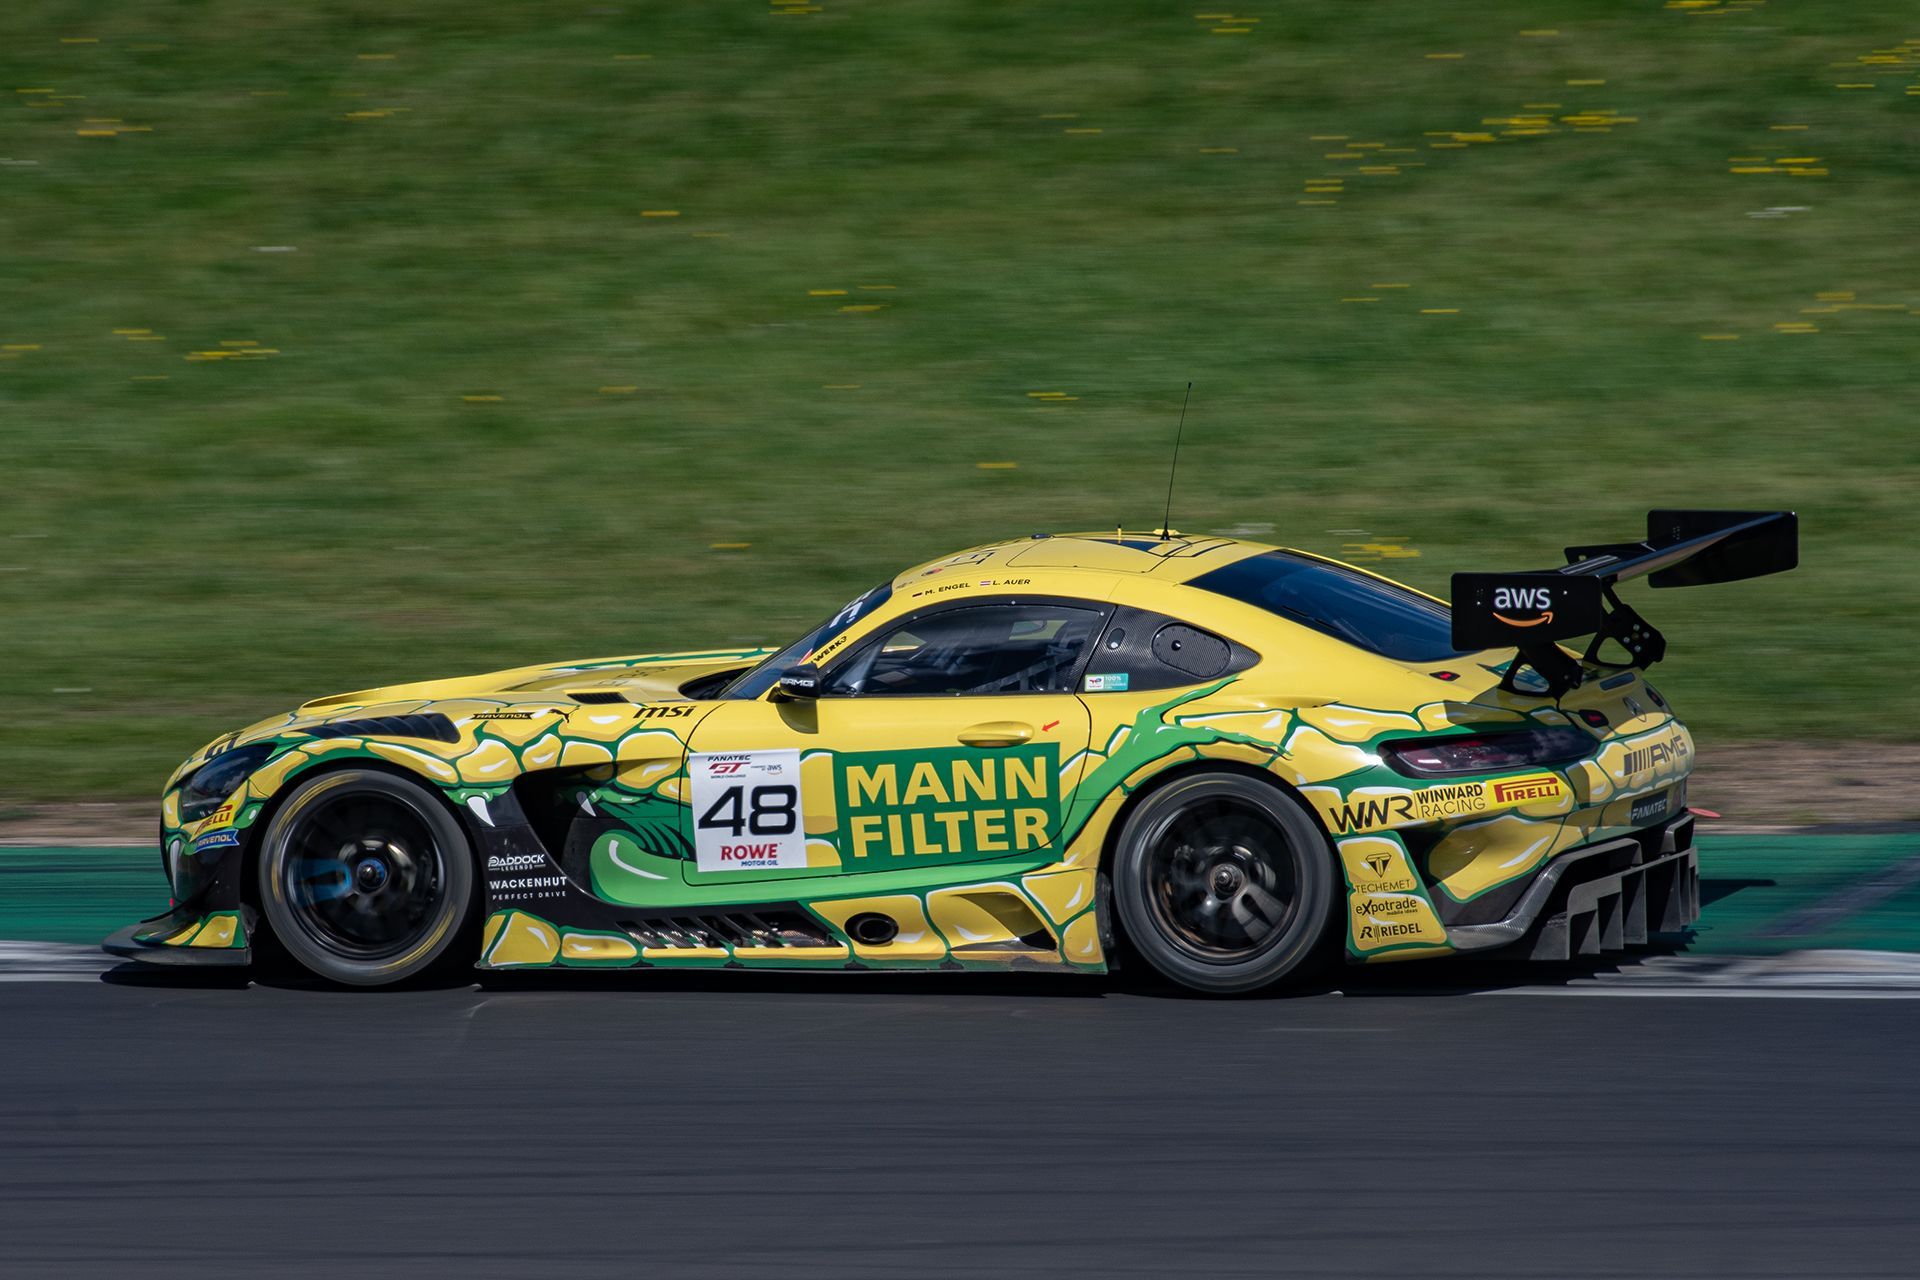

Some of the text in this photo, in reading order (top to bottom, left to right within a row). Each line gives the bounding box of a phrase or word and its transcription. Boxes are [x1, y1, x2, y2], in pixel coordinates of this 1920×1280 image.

[925, 582, 971, 596] M. ENGEL
[1494, 586, 1551, 609] aws
[633, 705, 698, 719] msi
[707, 754, 752, 762] FANATEC
[846, 756, 1048, 808] MANN
[1416, 784, 1484, 805] WINWARD
[1493, 777, 1560, 804] PIRELLI
[698, 784, 798, 837] 48
[1421, 797, 1487, 818] RACING
[1631, 799, 1667, 820] FANATEC
[850, 808, 1053, 858] FILTER
[720, 843, 778, 860] ROWE
[487, 854, 545, 868] PADDOCK
[501, 864, 533, 872] LEGENDS
[489, 876, 567, 890] WACKENHUT
[1355, 879, 1411, 894] TECHEMET
[492, 890, 567, 901] PERFECT DRIVE
[1380, 923, 1422, 937] RIEDEL
